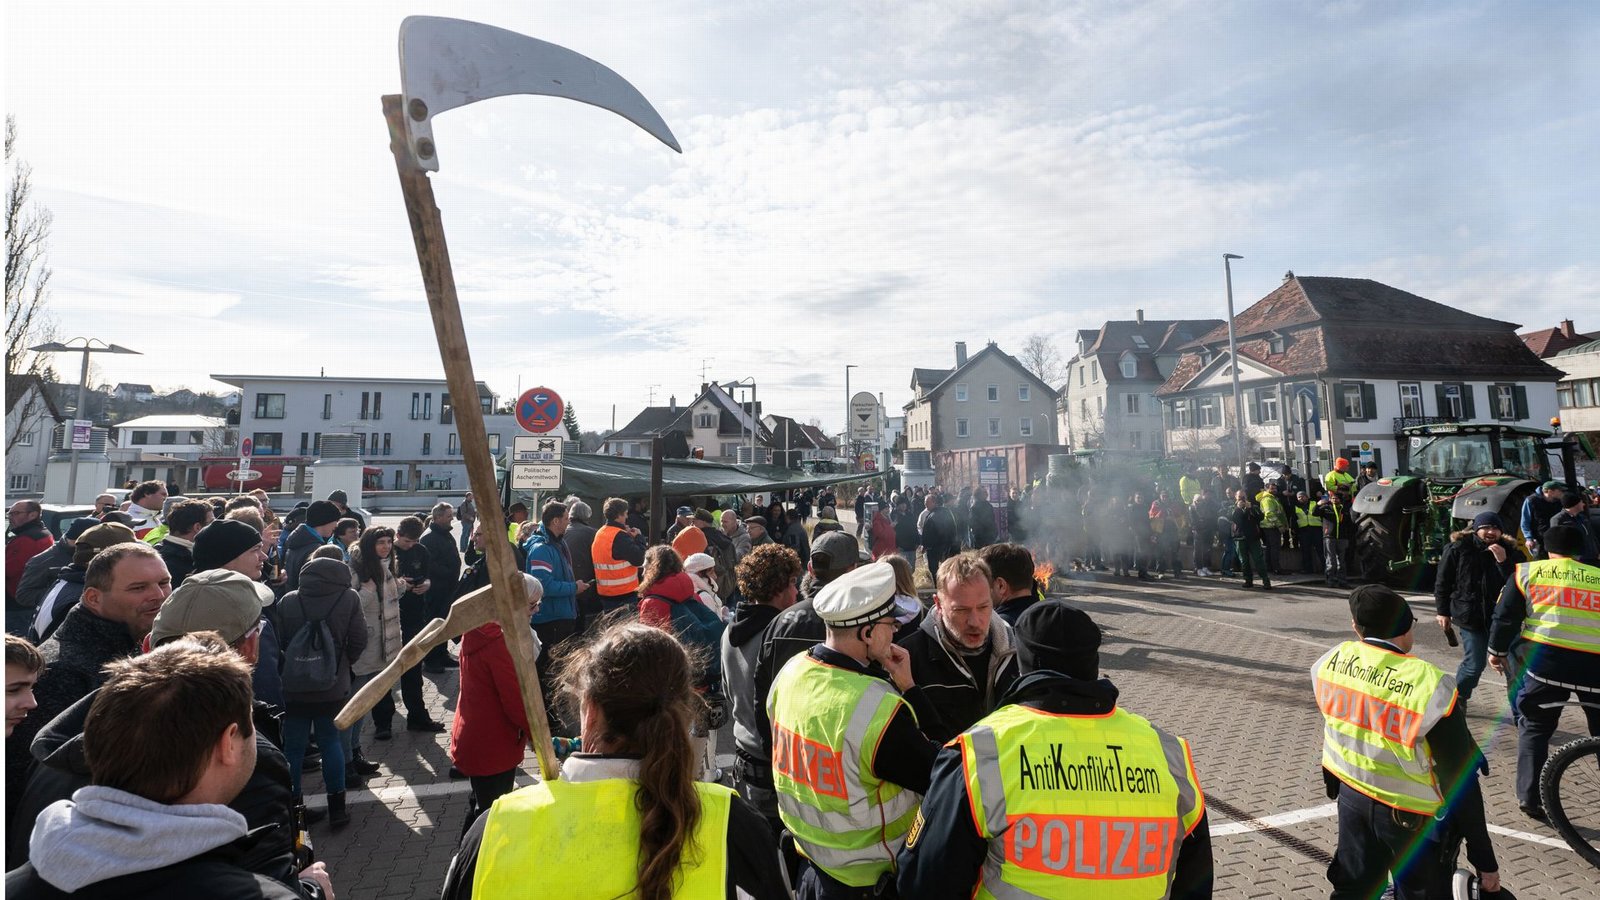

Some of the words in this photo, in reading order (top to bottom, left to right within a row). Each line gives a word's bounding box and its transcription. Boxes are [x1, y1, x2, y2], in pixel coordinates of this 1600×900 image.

[1534, 586, 1600, 611] POLIZE
[1326, 650, 1414, 697] AntiKonfliktTeam
[1321, 683, 1413, 743] POLIZEI
[1020, 743, 1161, 794] AntiKonfliktTeam
[1014, 816, 1170, 875] POLIZEI
